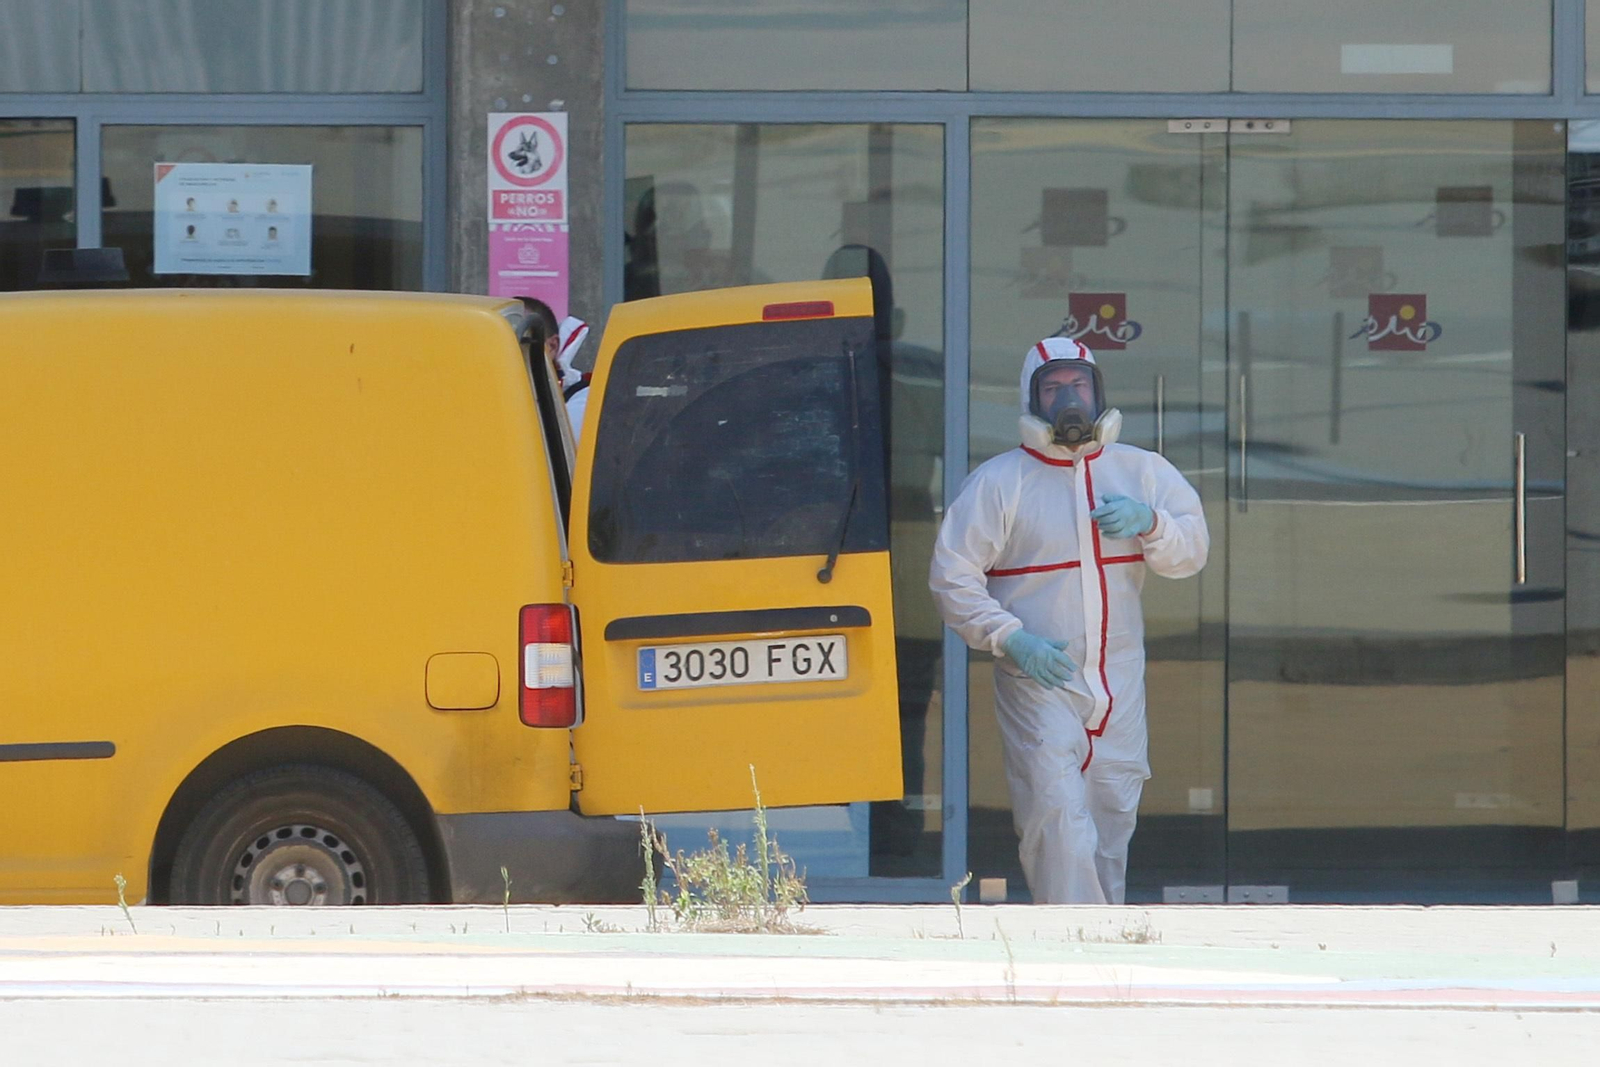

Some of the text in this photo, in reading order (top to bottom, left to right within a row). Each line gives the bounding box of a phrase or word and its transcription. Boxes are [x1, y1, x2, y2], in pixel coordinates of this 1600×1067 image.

[500, 193, 554, 204] PERROS
[663, 641, 836, 683] 3030 FGX
[644, 672, 652, 683] E
